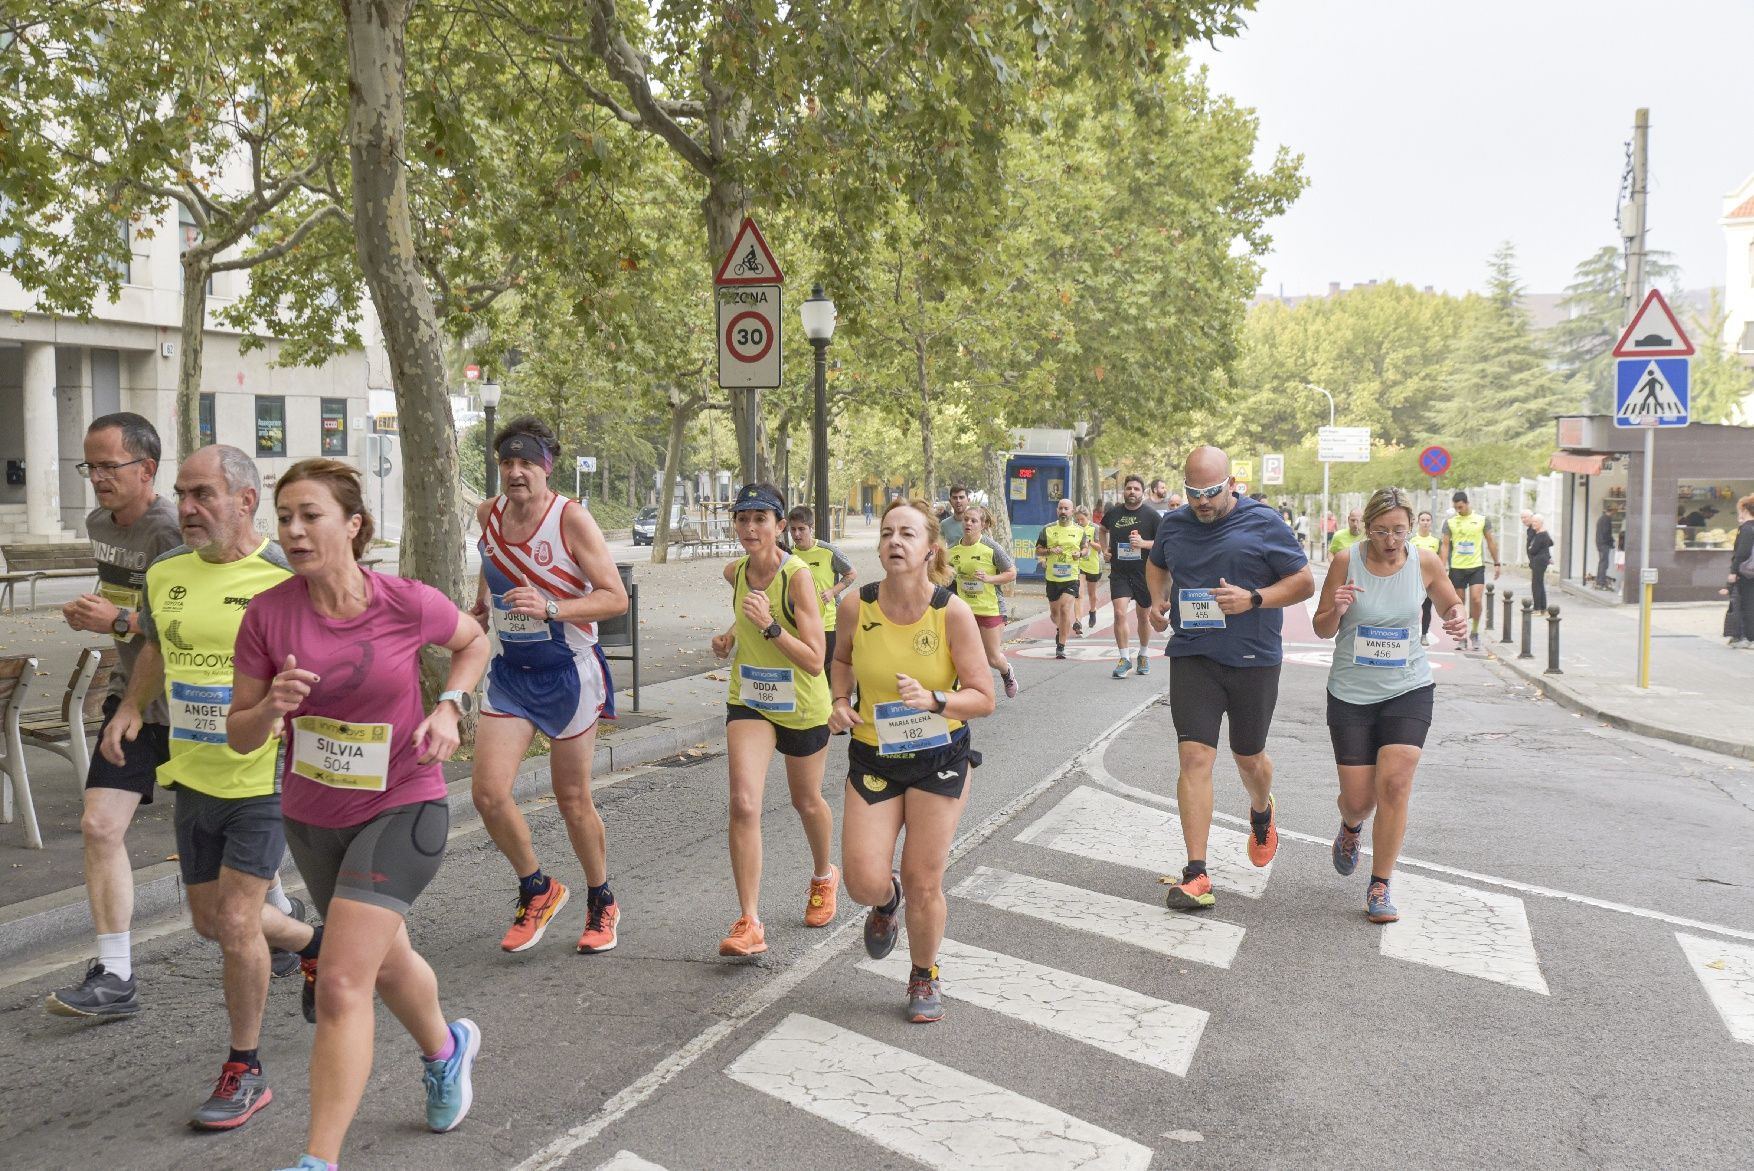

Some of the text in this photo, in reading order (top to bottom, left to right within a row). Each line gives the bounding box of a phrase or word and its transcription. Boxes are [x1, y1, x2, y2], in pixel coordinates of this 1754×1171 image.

[734, 291, 768, 304] ZONA
[737, 328, 763, 346] 30
[1192, 602, 1209, 610] TONI
[504, 612, 530, 622] JORDI
[509, 623, 526, 632] 264
[1366, 640, 1401, 649] VANESSA
[1373, 650, 1391, 659] 456
[752, 682, 778, 692] ODDA
[185, 689, 223, 699] inmoovs
[758, 693, 774, 702] 186
[184, 703, 227, 718] ANGEL
[194, 717, 217, 731] 275
[888, 715, 932, 728] MARIA ELENA
[319, 722, 366, 737] inmovs
[902, 727, 924, 740] 182
[316, 738, 364, 758] SILVIA
[323, 756, 351, 773] 504
